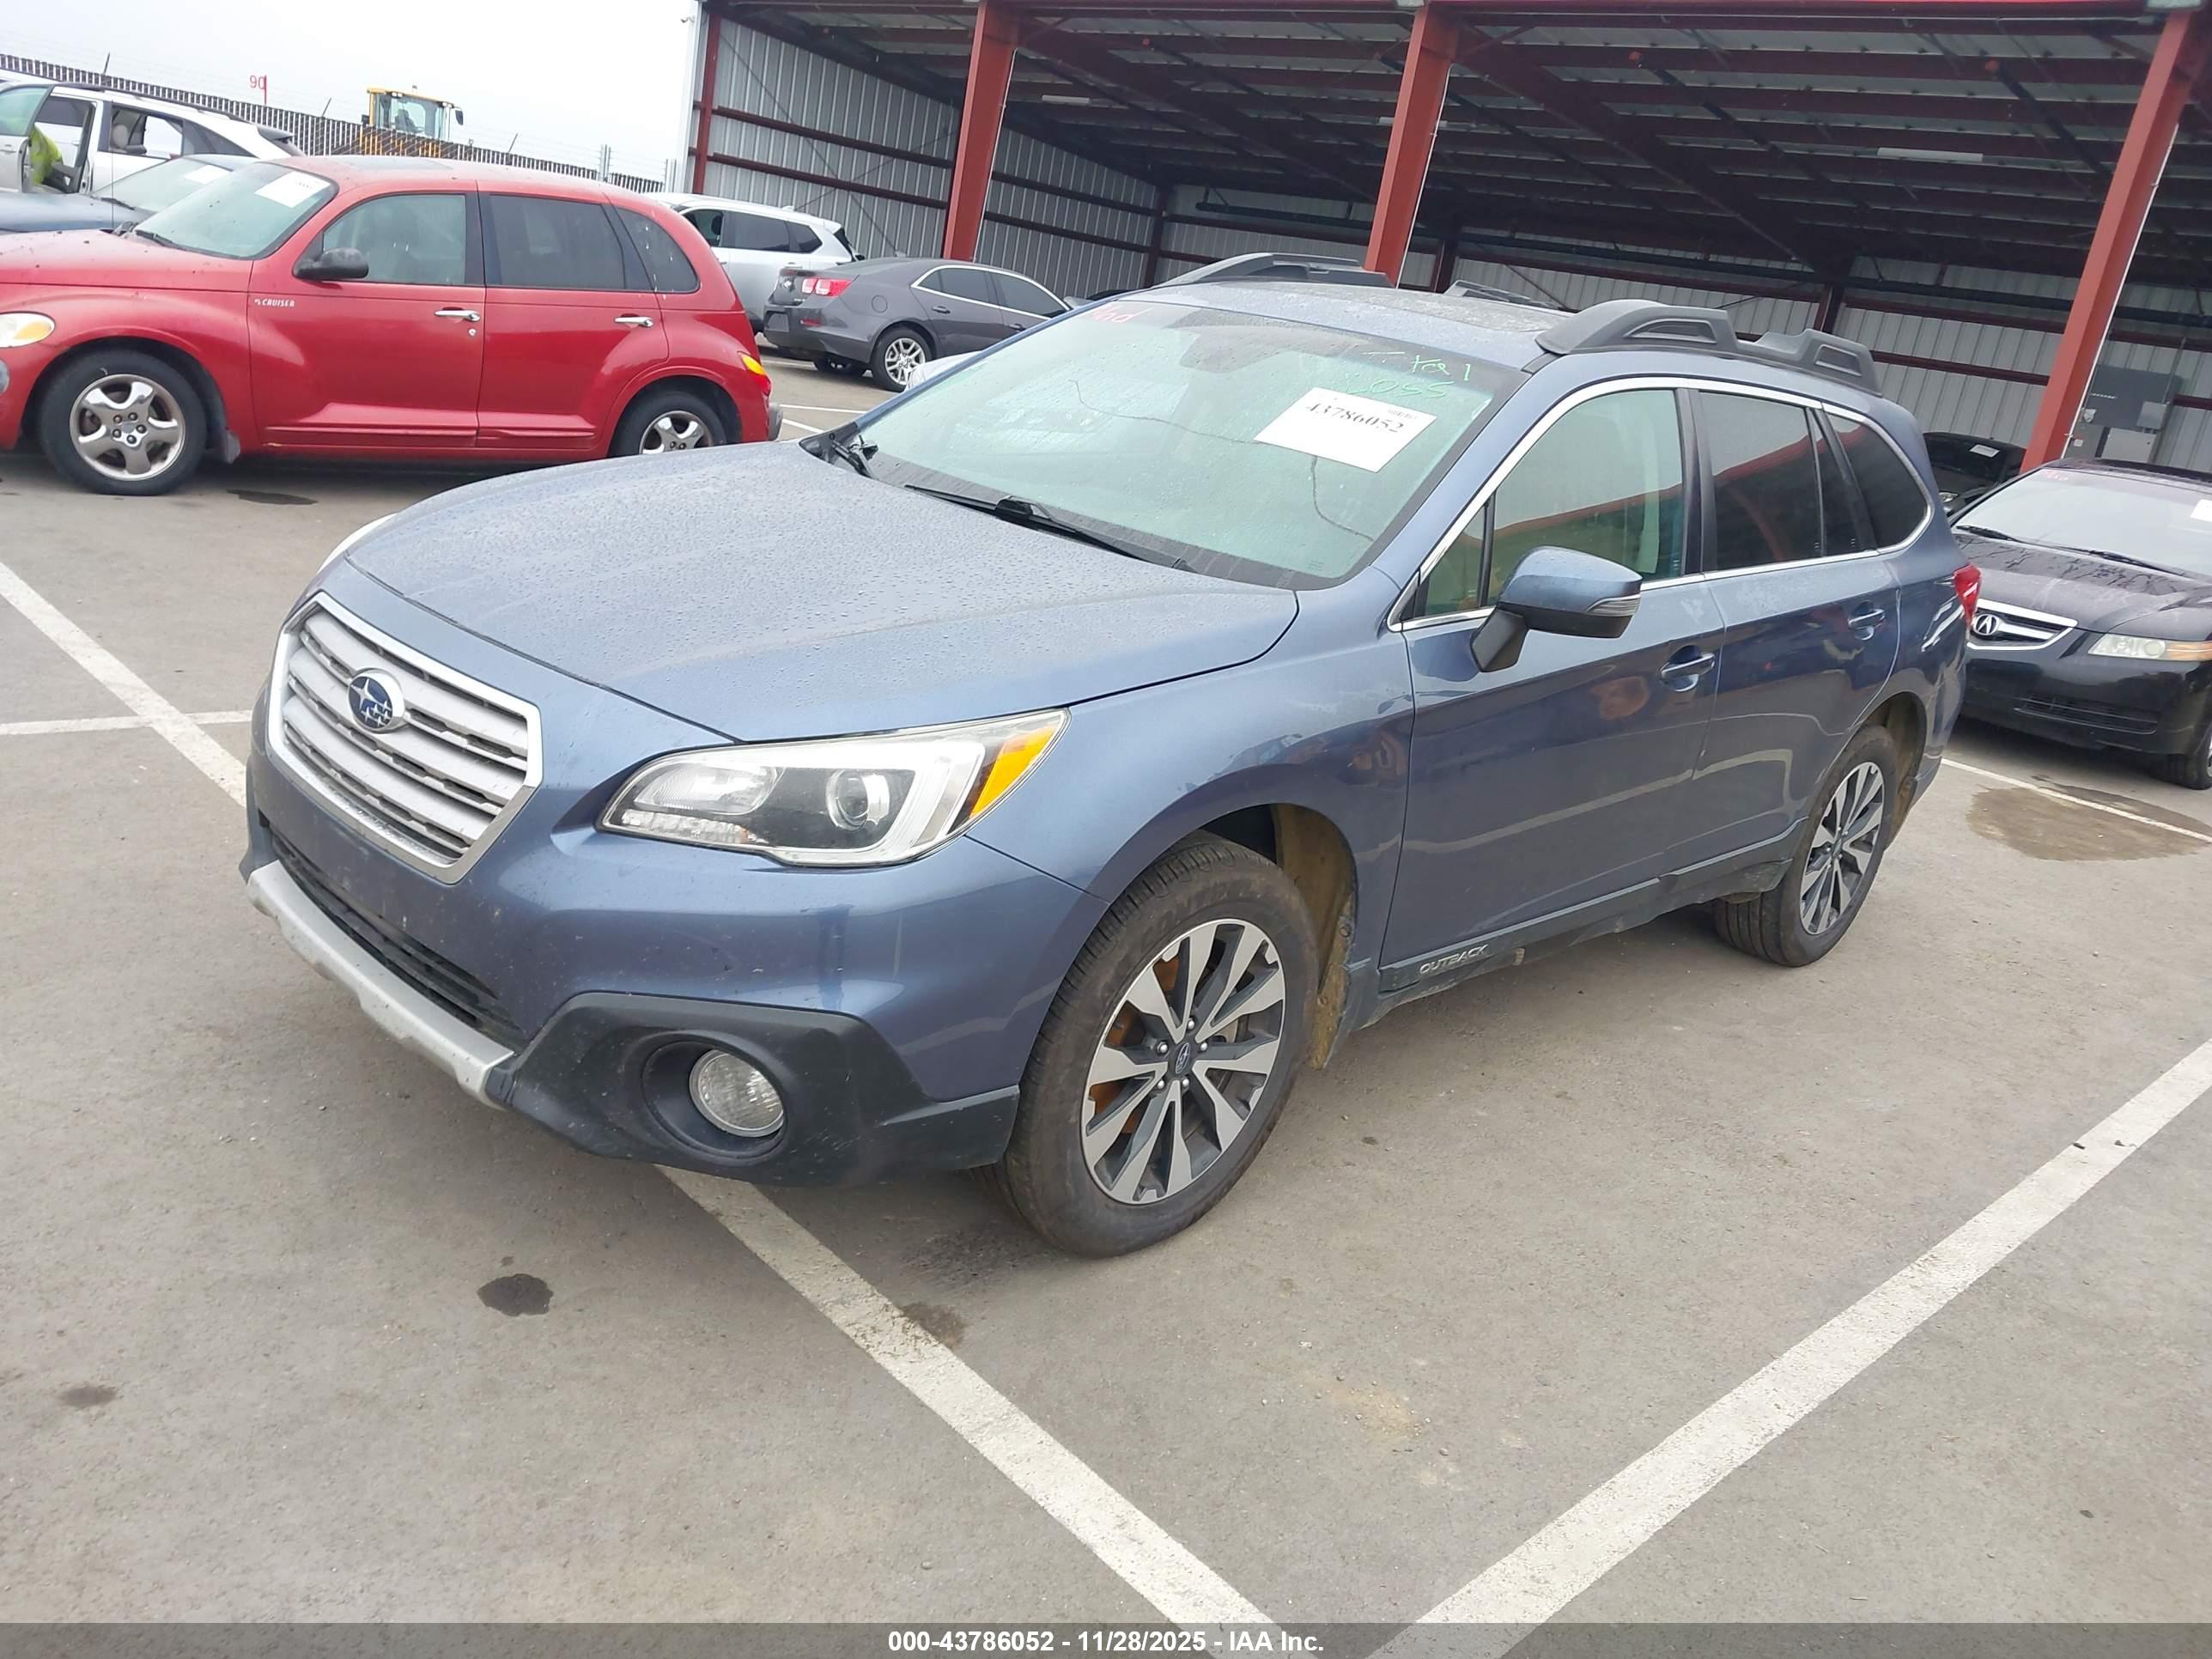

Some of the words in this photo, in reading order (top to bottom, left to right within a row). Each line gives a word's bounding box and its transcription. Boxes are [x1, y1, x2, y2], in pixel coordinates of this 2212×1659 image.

[262, 298, 295, 307] CRUISER
[1307, 402, 1405, 434] 43786052
[1419, 944, 1489, 975] OUTBACK
